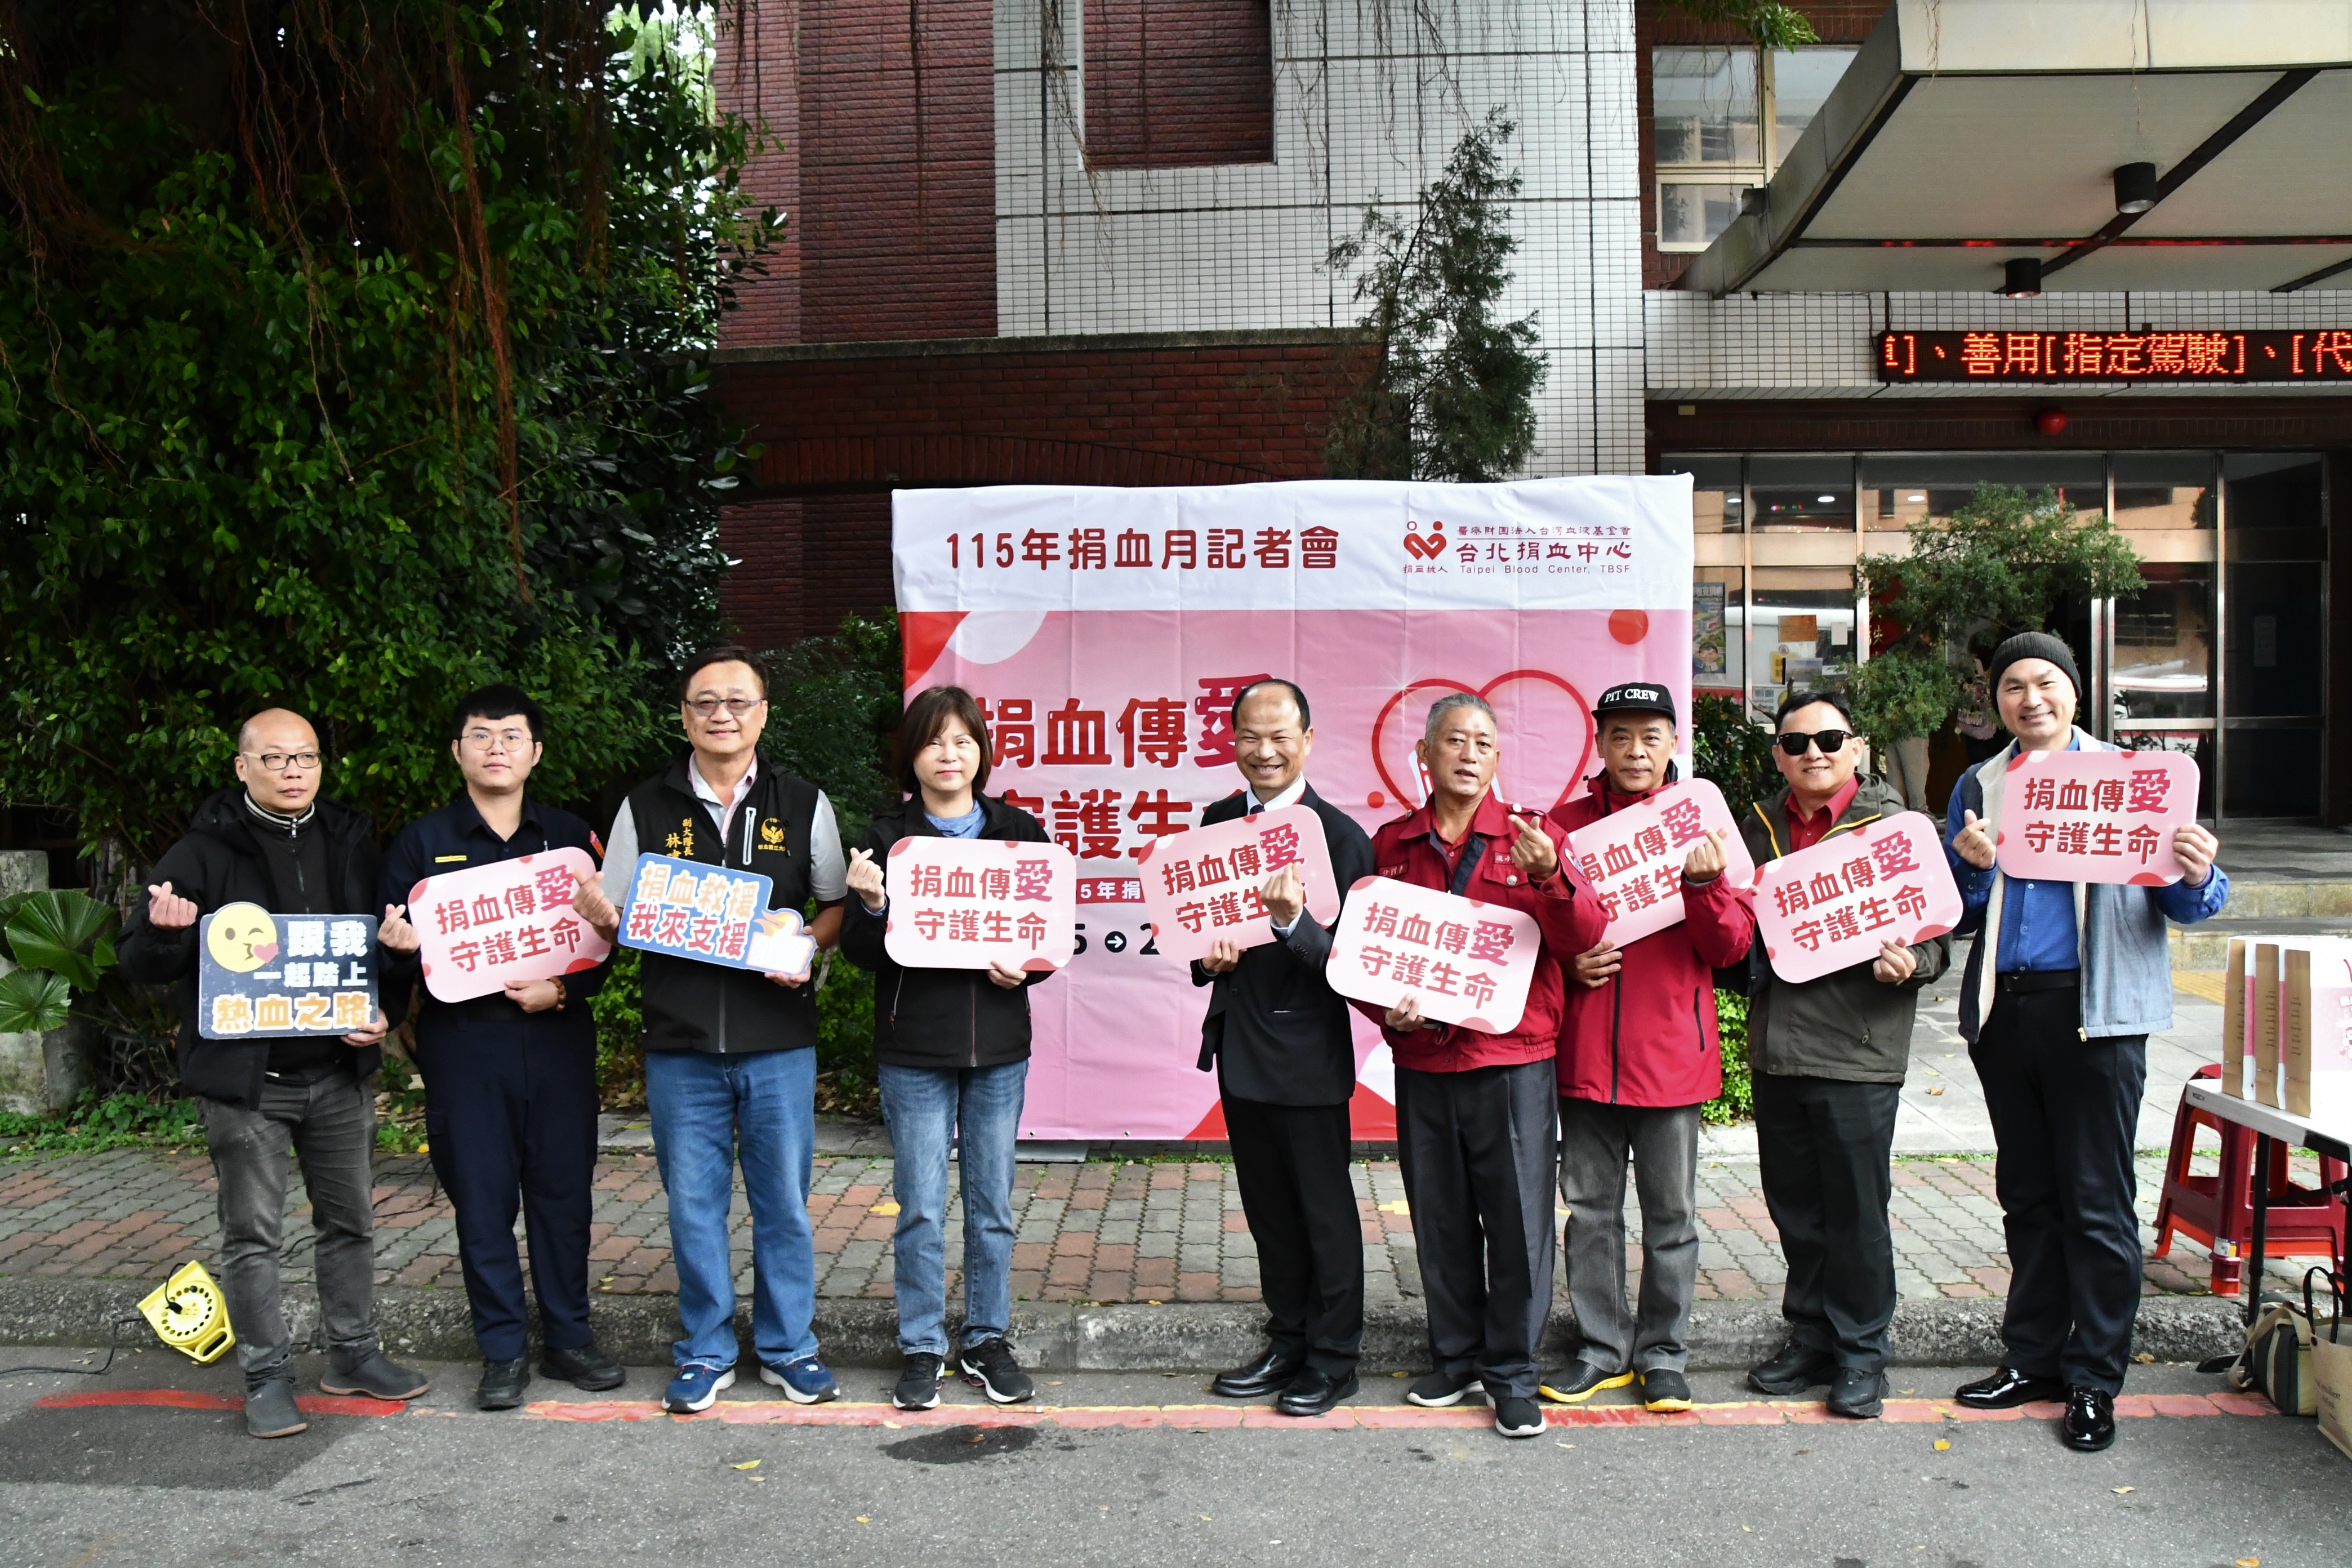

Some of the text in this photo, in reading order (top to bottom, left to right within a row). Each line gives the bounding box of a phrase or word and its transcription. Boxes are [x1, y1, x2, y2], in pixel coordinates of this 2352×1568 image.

[947, 526, 1339, 570] 115年捐血月記者會
[1456, 541, 1632, 563] 台北捐血中心
[1457, 525, 1632, 536] 醫療財團法人台灣血液基金會
[1403, 564, 1448, 574] 捐血救人
[1460, 565, 1631, 575] Taipei Blood Center, TBSF
[1604, 688, 1659, 703] PIT CREW
[2024, 768, 2170, 814] 捐血傳愛
[1162, 823, 1305, 896] 捐血傳愛
[2024, 820, 2161, 865] 守護生命
[636, 862, 759, 919] 捐血救援
[910, 859, 1053, 902] 捐血傳愛
[1774, 830, 1921, 917] 捐血傳愛
[435, 865, 576, 935] 捐血傳愛
[1175, 883, 1308, 933] 守護生
[1791, 884, 1927, 952] 守護生命
[288, 920, 367, 956] 跟我
[449, 917, 582, 972] 守護生命
[627, 903, 750, 960] 我來支援
[914, 908, 1047, 950] 守護生命
[1362, 902, 1515, 967] 捐血傳愛
[253, 961, 368, 987] 一起踏上
[1360, 945, 1498, 1010] 守護生命
[212, 992, 369, 1034] 熱血之路
